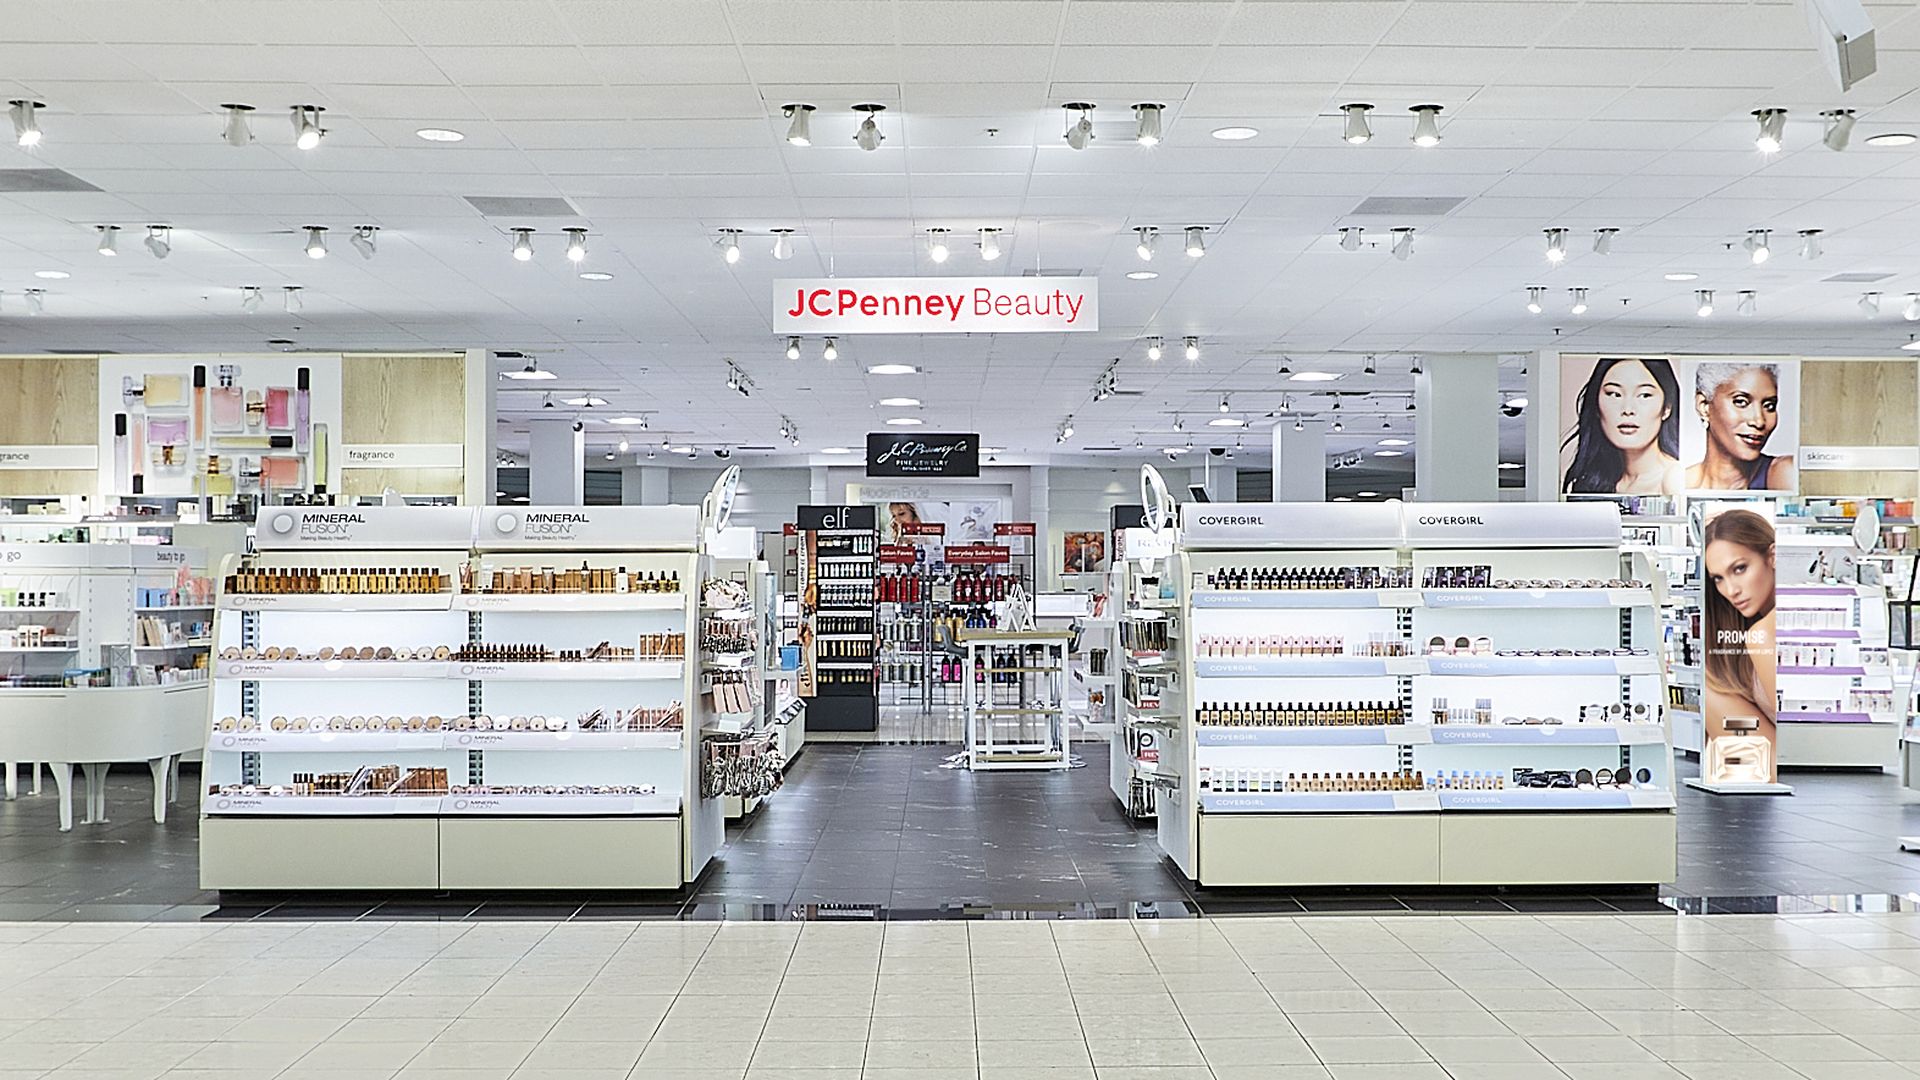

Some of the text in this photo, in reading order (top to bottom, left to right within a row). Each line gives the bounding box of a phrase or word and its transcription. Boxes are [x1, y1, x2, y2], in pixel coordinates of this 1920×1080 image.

[788, 288, 1083, 323] JCPenney Beauty
[349, 450, 395, 461] fragrance
[302, 514, 366, 523] MINERAL
[526, 514, 590, 523] MINERAL
[1198, 516, 1265, 525] COVERGIRL
[1418, 516, 1484, 525] COVERGIRL
[301, 524, 347, 534] FUSION
[525, 524, 570, 534] FUSION
[7, 552, 22, 563] go
[948, 550, 974, 558] Everyday
[1717, 630, 1766, 644] PROMISE
